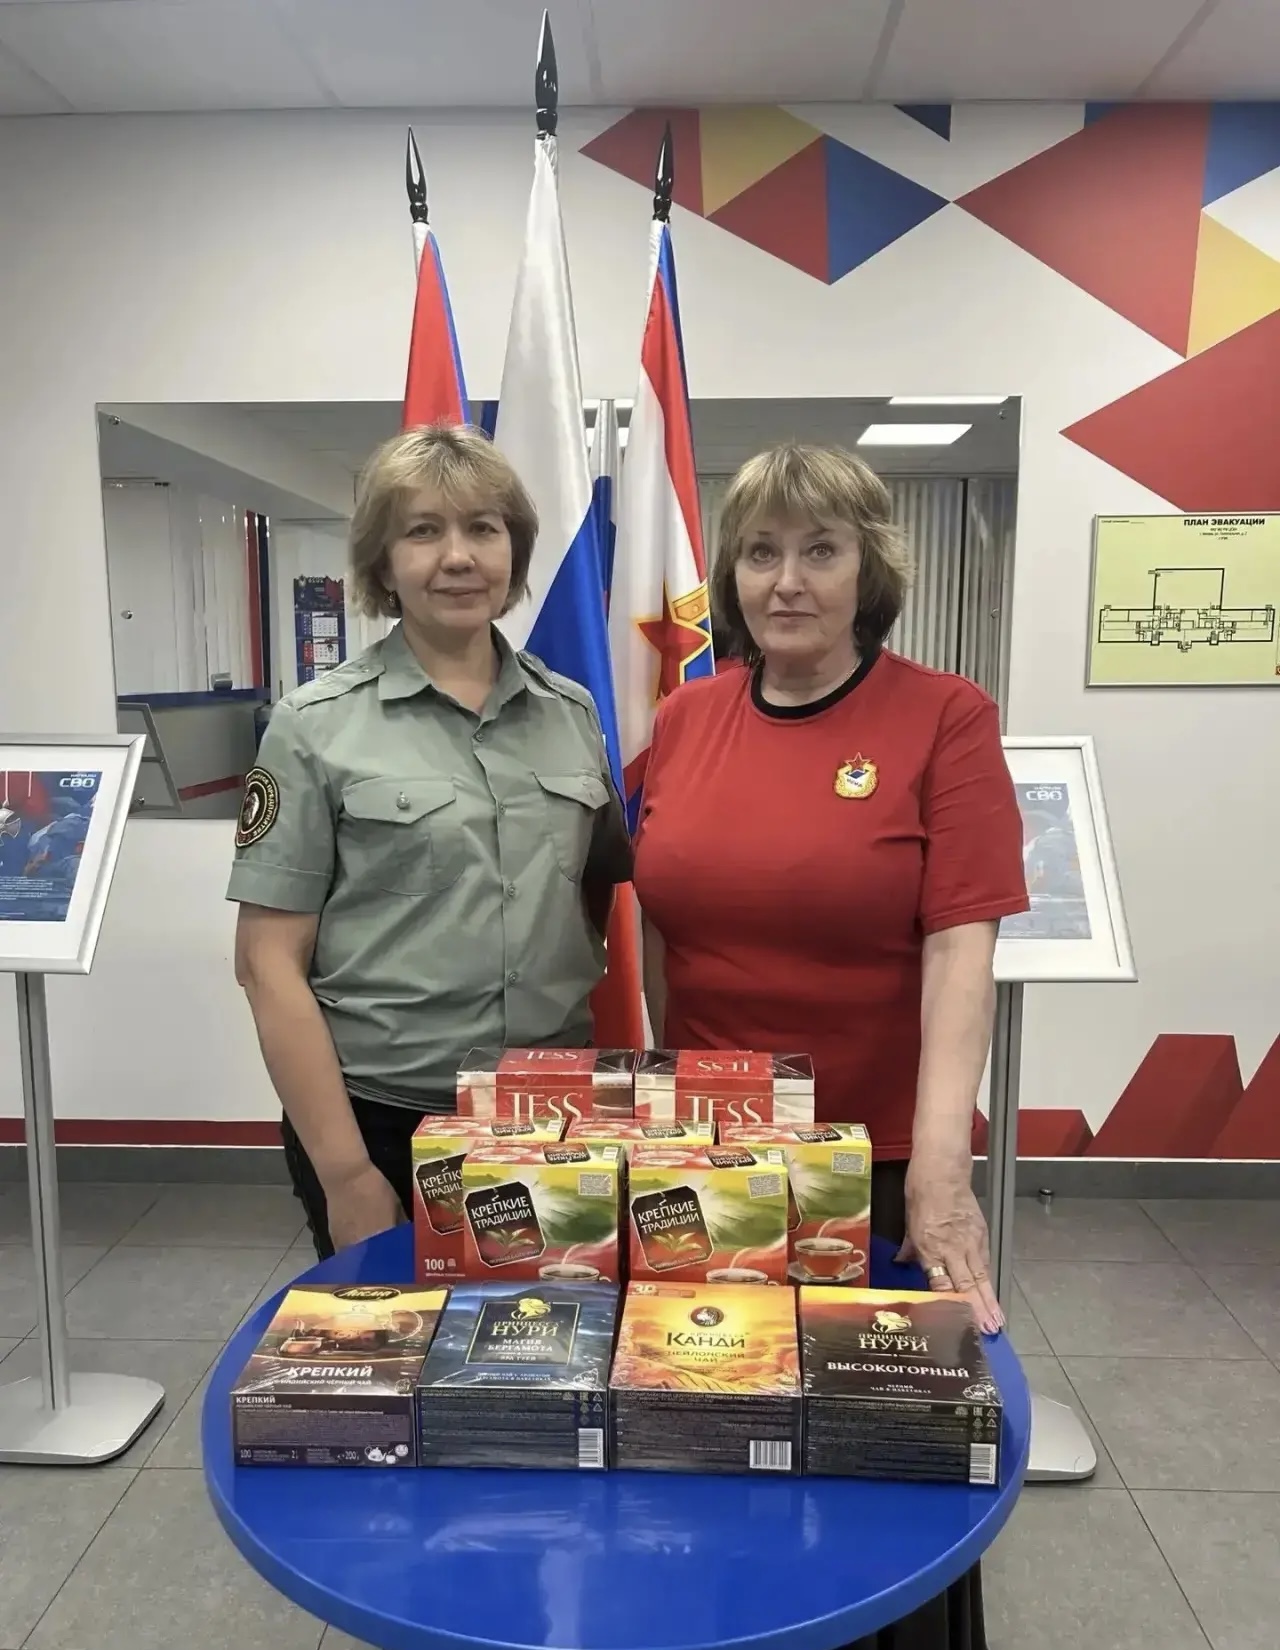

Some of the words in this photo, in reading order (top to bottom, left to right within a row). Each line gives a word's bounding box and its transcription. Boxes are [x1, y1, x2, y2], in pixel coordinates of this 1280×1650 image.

[1183, 518, 1209, 526] ПЛАН
[1211, 518, 1265, 527] ЭВАКУАЦИИ
[59, 777, 95, 788] СВО
[1026, 790, 1062, 801] СВО
[526, 1050, 579, 1060] TESS
[506, 1092, 582, 1119] TESS
[685, 1095, 762, 1122] TESS
[422, 1169, 463, 1189] КРЕПК
[425, 1183, 463, 1199] ТРАДИЦ
[471, 1196, 529, 1219] КРЕПКИЕ
[638, 1200, 697, 1224] КРЕПКИЕ
[475, 1208, 532, 1229] ТРАДИЦИИ
[641, 1212, 700, 1234] ТРАДИЦИИ
[424, 1258, 445, 1270] 100
[490, 1325, 558, 1336] НУРИ
[858, 1338, 929, 1352] НУРИ
[288, 1364, 374, 1378] КРЕПКИЙ
[826, 1361, 970, 1378] ВЫСОКОГОРНЫЙ
[236, 1395, 276, 1404] КРЕПКИЙ
